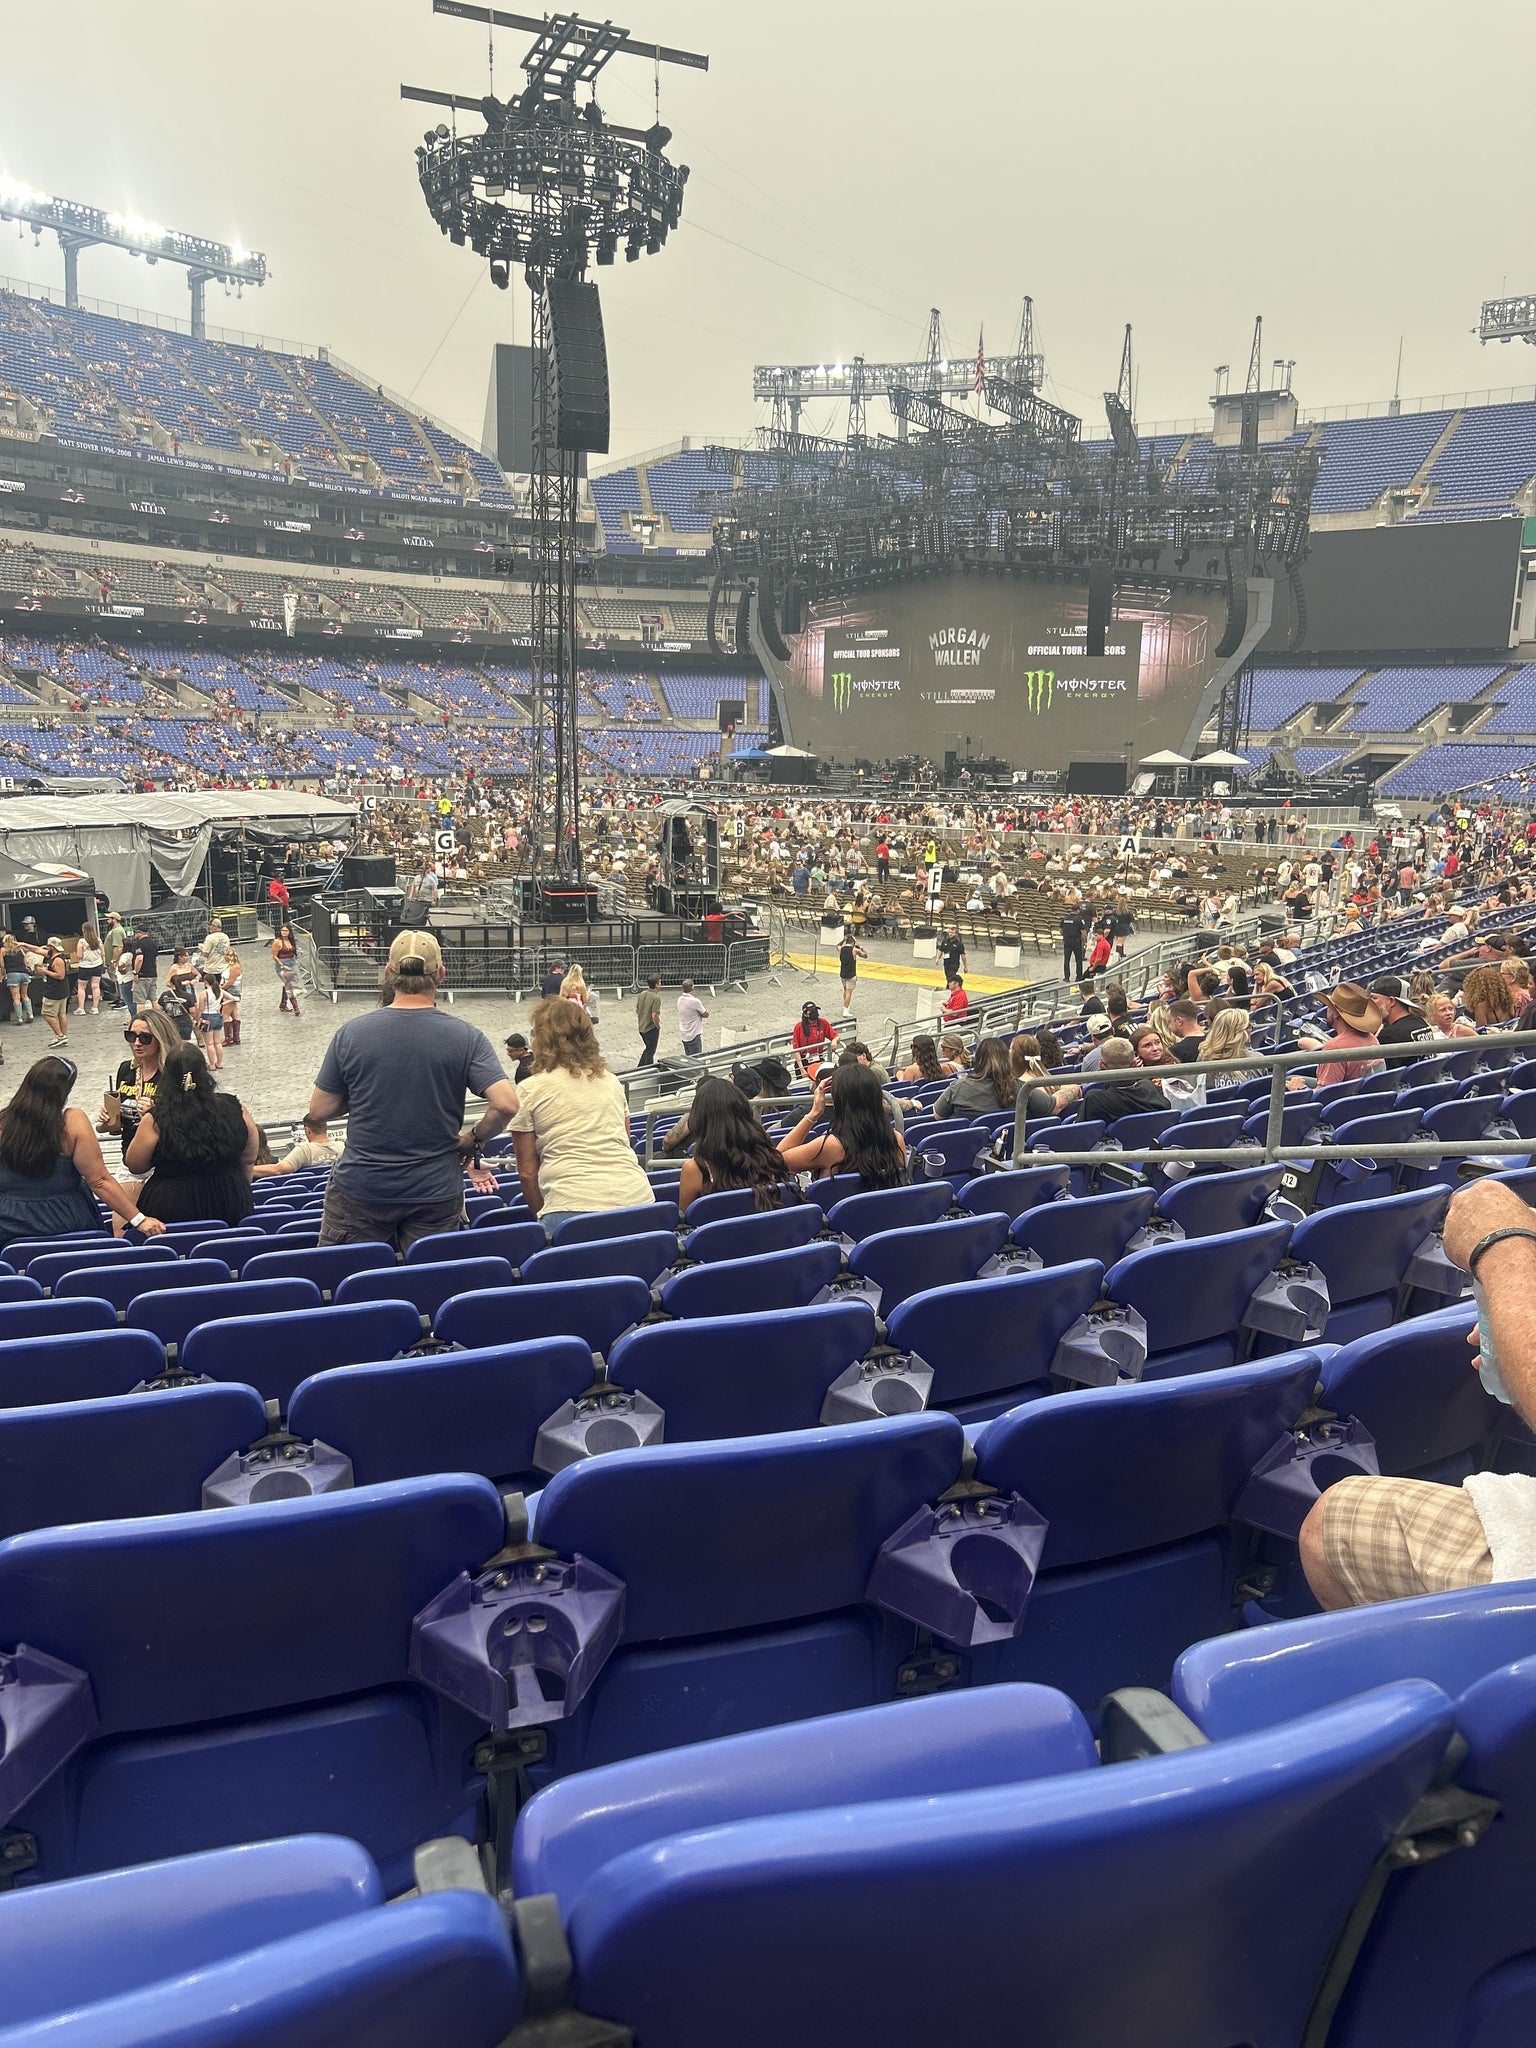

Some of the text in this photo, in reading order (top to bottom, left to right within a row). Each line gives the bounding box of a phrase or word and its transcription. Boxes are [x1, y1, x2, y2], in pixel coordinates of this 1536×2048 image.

[0, 429, 33, 442] 002-2012
[58, 438, 131, 457] MATT STOVER 1996-2008
[147, 453, 214, 471] JAMAL LEWIS 2000-2006
[227, 467, 242, 476] TODD
[243, 470, 257, 478] HEAP
[308, 481, 372, 495] BRIAN BILLICK 1999-2007
[411, 494, 428, 502] NGATA
[429, 497, 456, 505] 2006-2014
[130, 502, 166, 515] WALLEN
[402, 537, 435, 547] WALLEN
[85, 605, 112, 613] STILL
[249, 620, 283, 630] WALLEN
[928, 627, 990, 650] MORGAN
[833, 648, 900, 659] OFFICIAL TOUR SPONSORS
[1028, 645, 1126, 656] OFFICIAL TOUR SSORS
[934, 649, 980, 666] WALLEN
[852, 679, 901, 692] MONSTER
[1056, 678, 1127, 692] MONSTER
[920, 691, 950, 700] STILL
[5, 778, 12, 788] E
[366, 797, 374, 808] C
[736, 822, 743, 835] B
[437, 833, 453, 850] G
[1122, 838, 1136, 853] A
[932, 871, 940, 885] F
[10, 889, 42, 900] TOUR
[1286, 1175, 1294, 1185] 12
